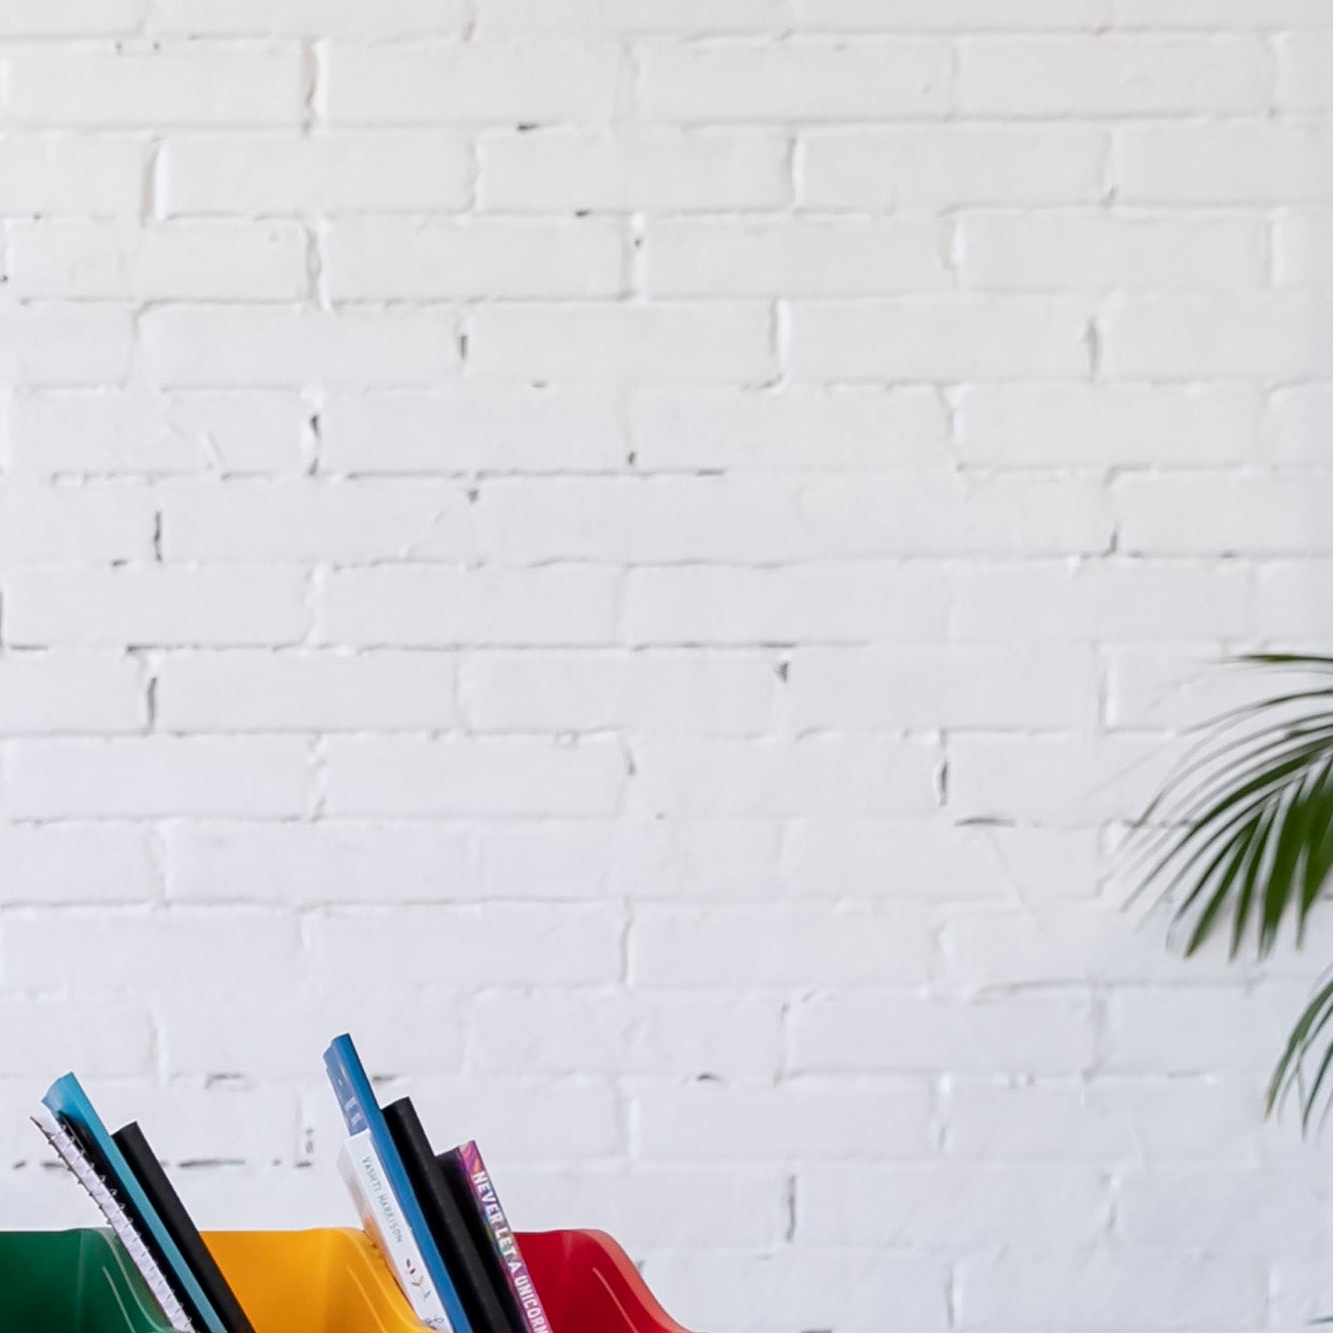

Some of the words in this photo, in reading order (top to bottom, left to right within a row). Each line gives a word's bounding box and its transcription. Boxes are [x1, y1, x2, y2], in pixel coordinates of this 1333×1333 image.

[473, 1170, 504, 1226] NEVER
[494, 1227, 518, 1257] LET
[507, 1260, 523, 1274] A
